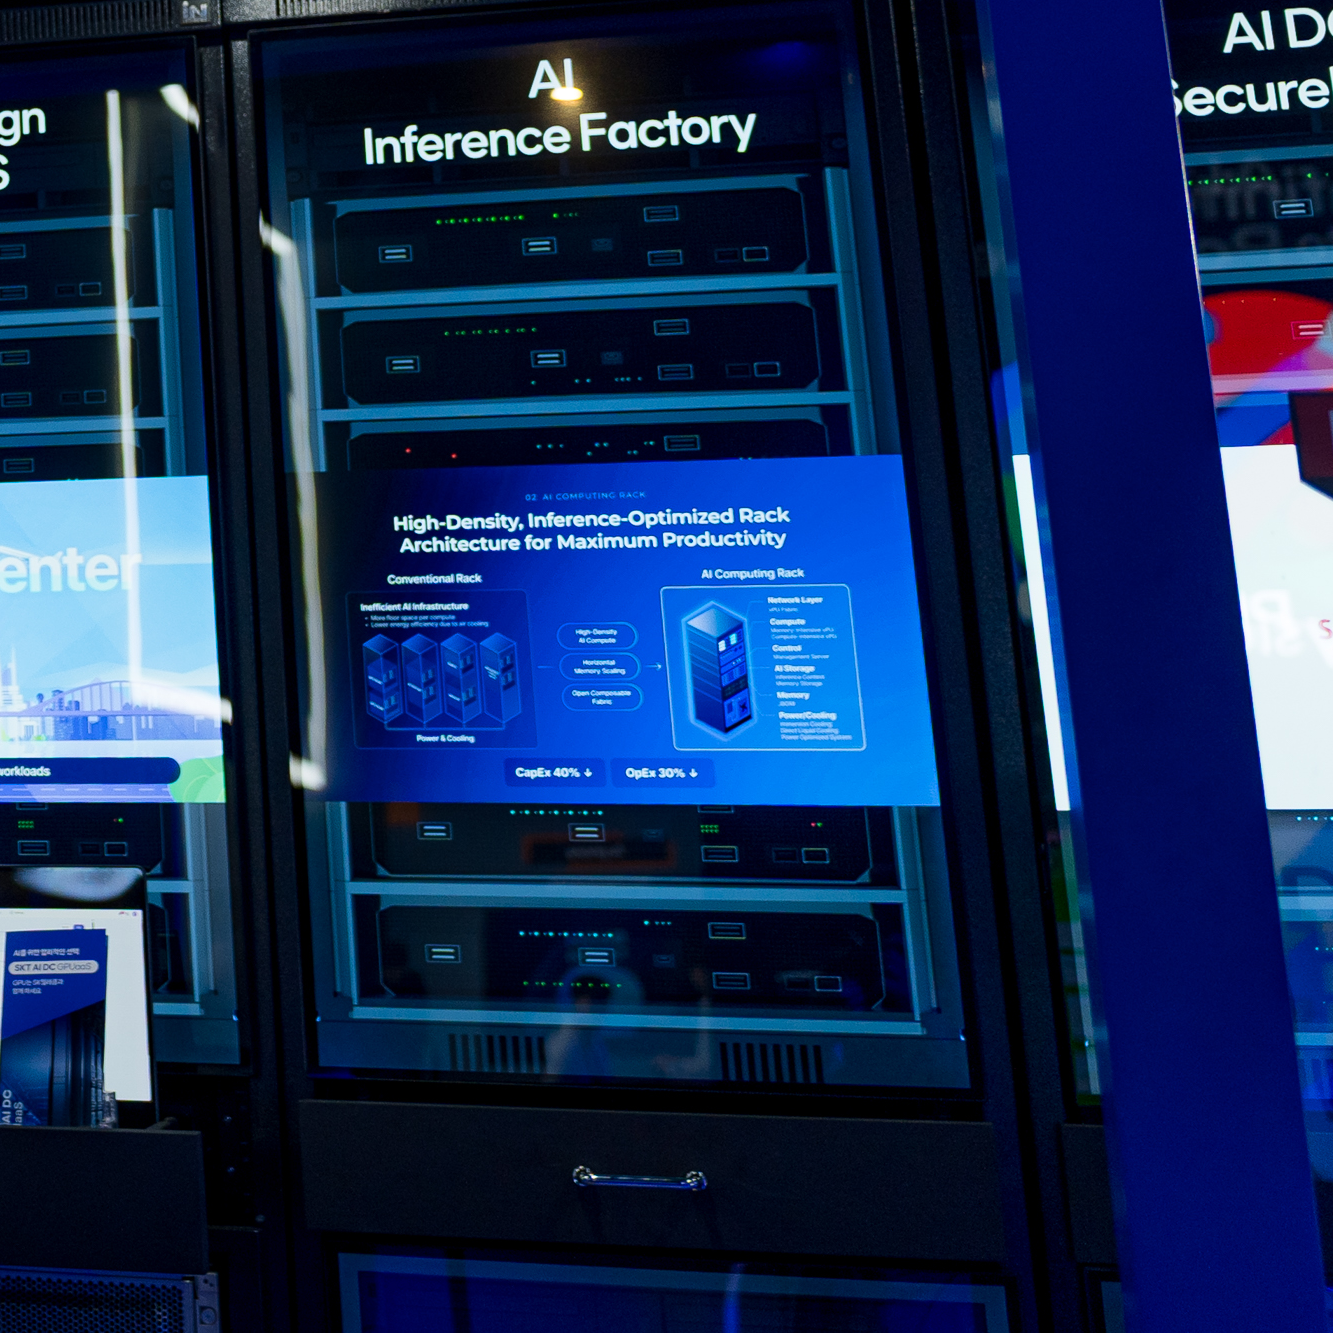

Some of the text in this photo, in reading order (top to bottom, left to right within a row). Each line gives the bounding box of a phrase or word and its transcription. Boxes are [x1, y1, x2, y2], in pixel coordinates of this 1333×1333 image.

[1223, 7, 1333, 54] AI D
[528, 58, 574, 99] AI
[1170, 66, 1333, 117] ecure
[363, 110, 758, 165] Inference Factory
[555, 491, 616, 502] COMPUTING
[618, 490, 647, 500] RACK
[393, 506, 791, 534] High-Density, Inference-Optimized Rack
[399, 529, 787, 553] Architecture for Maximum Productivity
[387, 572, 482, 585] Conventional Rack
[701, 568, 805, 581] AI Computing Rack
[767, 596, 823, 604] Network Layer
[360, 602, 470, 611] Inefficient AI Infrastructure
[770, 618, 806, 626] Compute
[586, 637, 616, 645] Compute
[772, 644, 802, 652] Control
[783, 664, 815, 673] Storage
[776, 692, 810, 700] Memory
[778, 711, 837, 721] Power/Cooling
[416, 734, 439, 743] Power
[446, 734, 475, 744] Cooling
[515, 767, 580, 779] CapEx 40%
[625, 767, 686, 780] OpEx 30%
[33, 963, 42, 971] AI
[42, 963, 56, 971] DC
[56, 962, 92, 971] GPUaaS
[2, 1089, 13, 1108] DC
[13, 1101, 24, 1126] aaS
